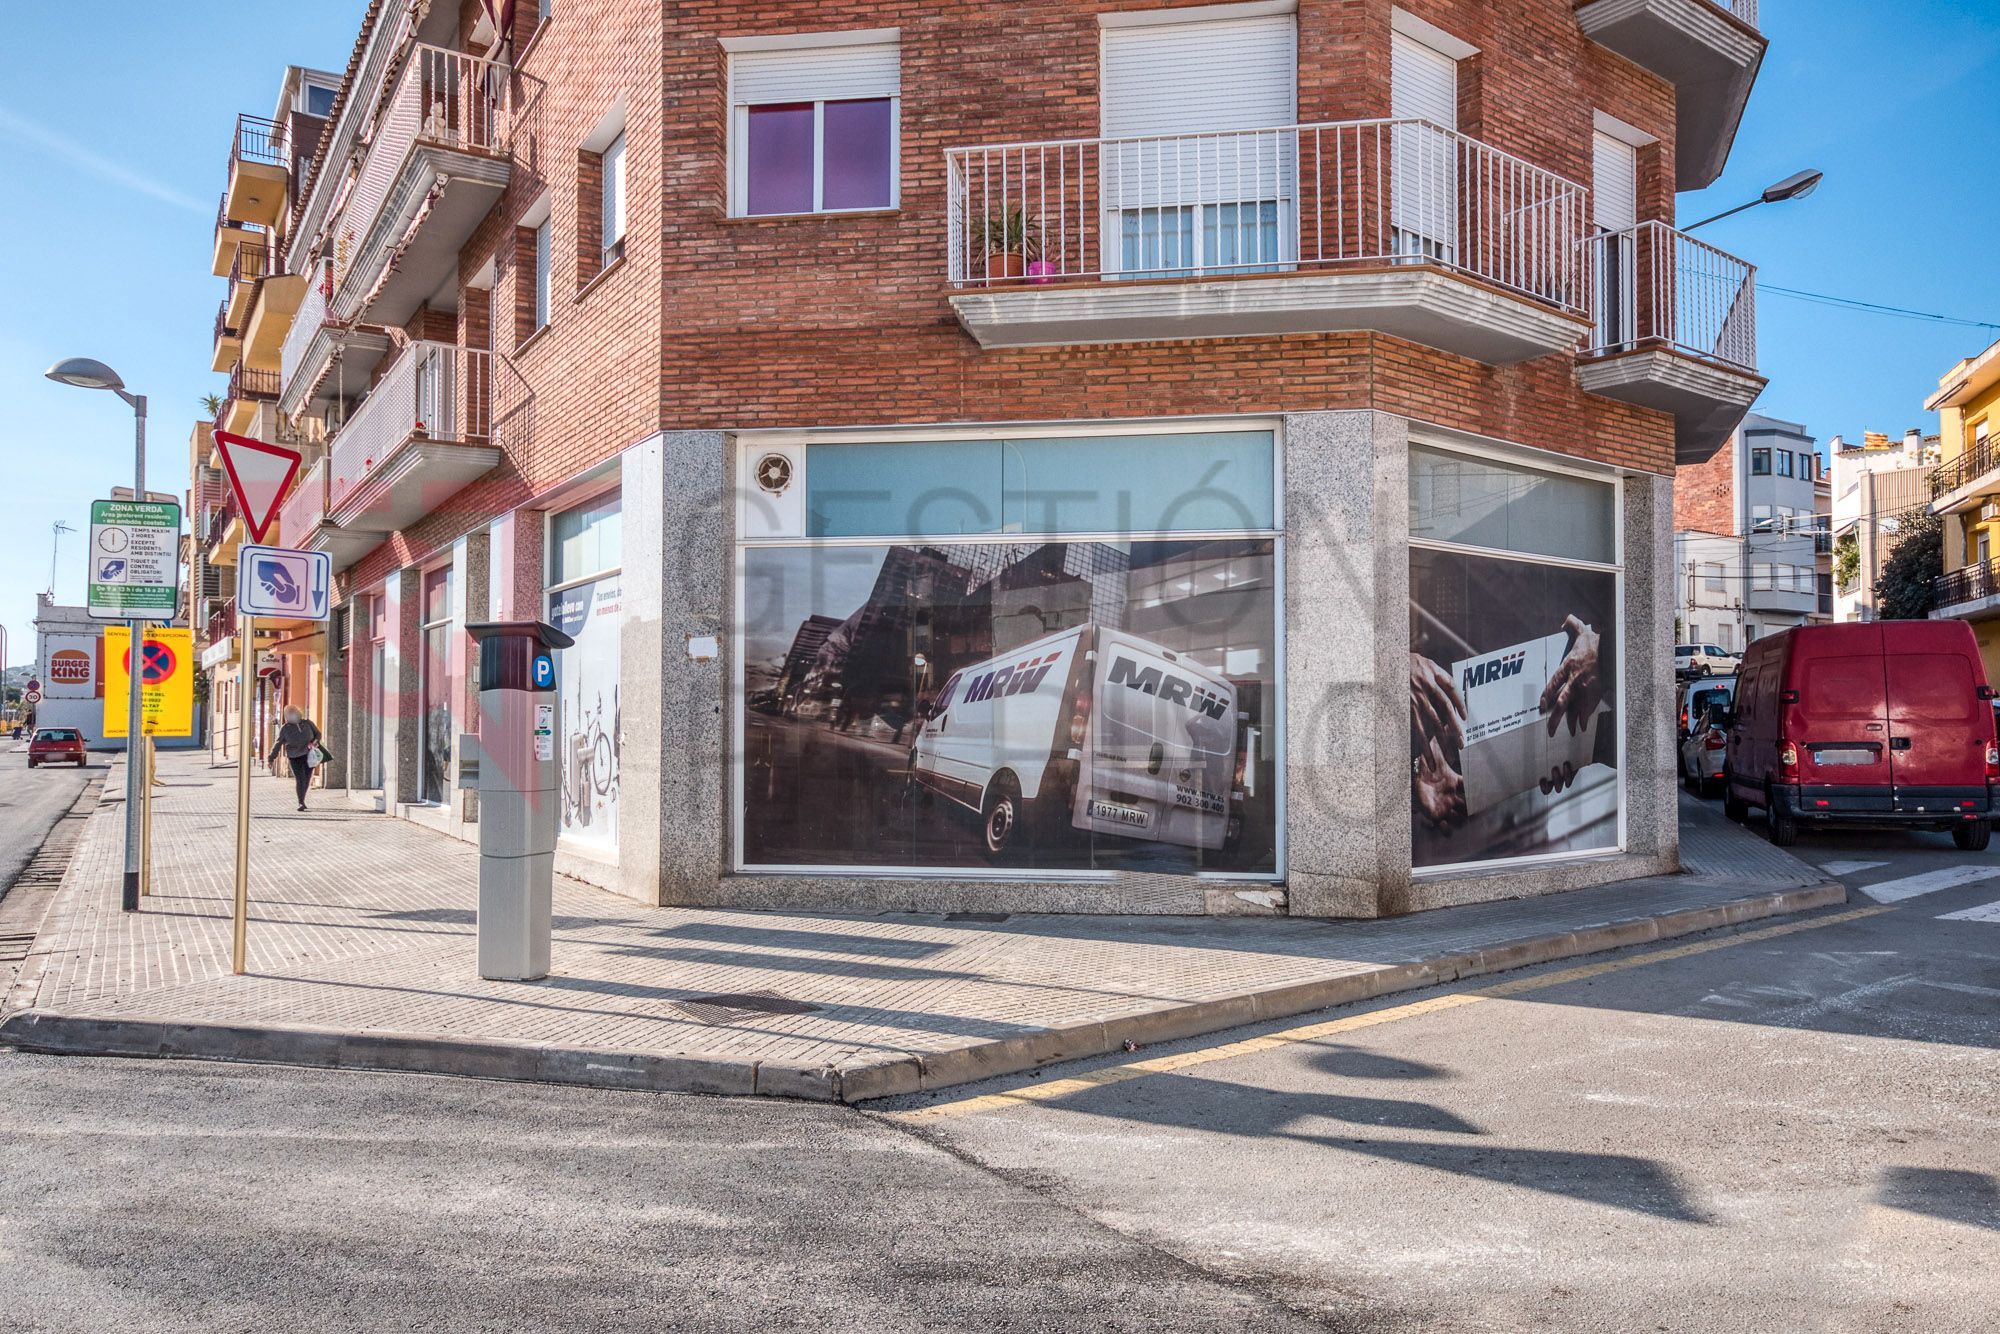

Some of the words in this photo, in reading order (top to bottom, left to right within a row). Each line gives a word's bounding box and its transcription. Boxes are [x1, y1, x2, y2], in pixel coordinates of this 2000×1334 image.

[110, 504, 132, 512] ZONA
[135, 504, 163, 513] VERDA
[51, 660, 90, 668] BURGER
[51, 667, 90, 678] KING
[537, 660, 550, 682] P
[1462, 651, 1526, 691] MRW
[963, 650, 1062, 704] MRW
[1107, 655, 1230, 721] MRW
[1176, 784, 1225, 803] www.mrw.es
[1176, 793, 1192, 806] 902
[1096, 805, 1118, 819] 1977
[1121, 810, 1146, 825] MRW
